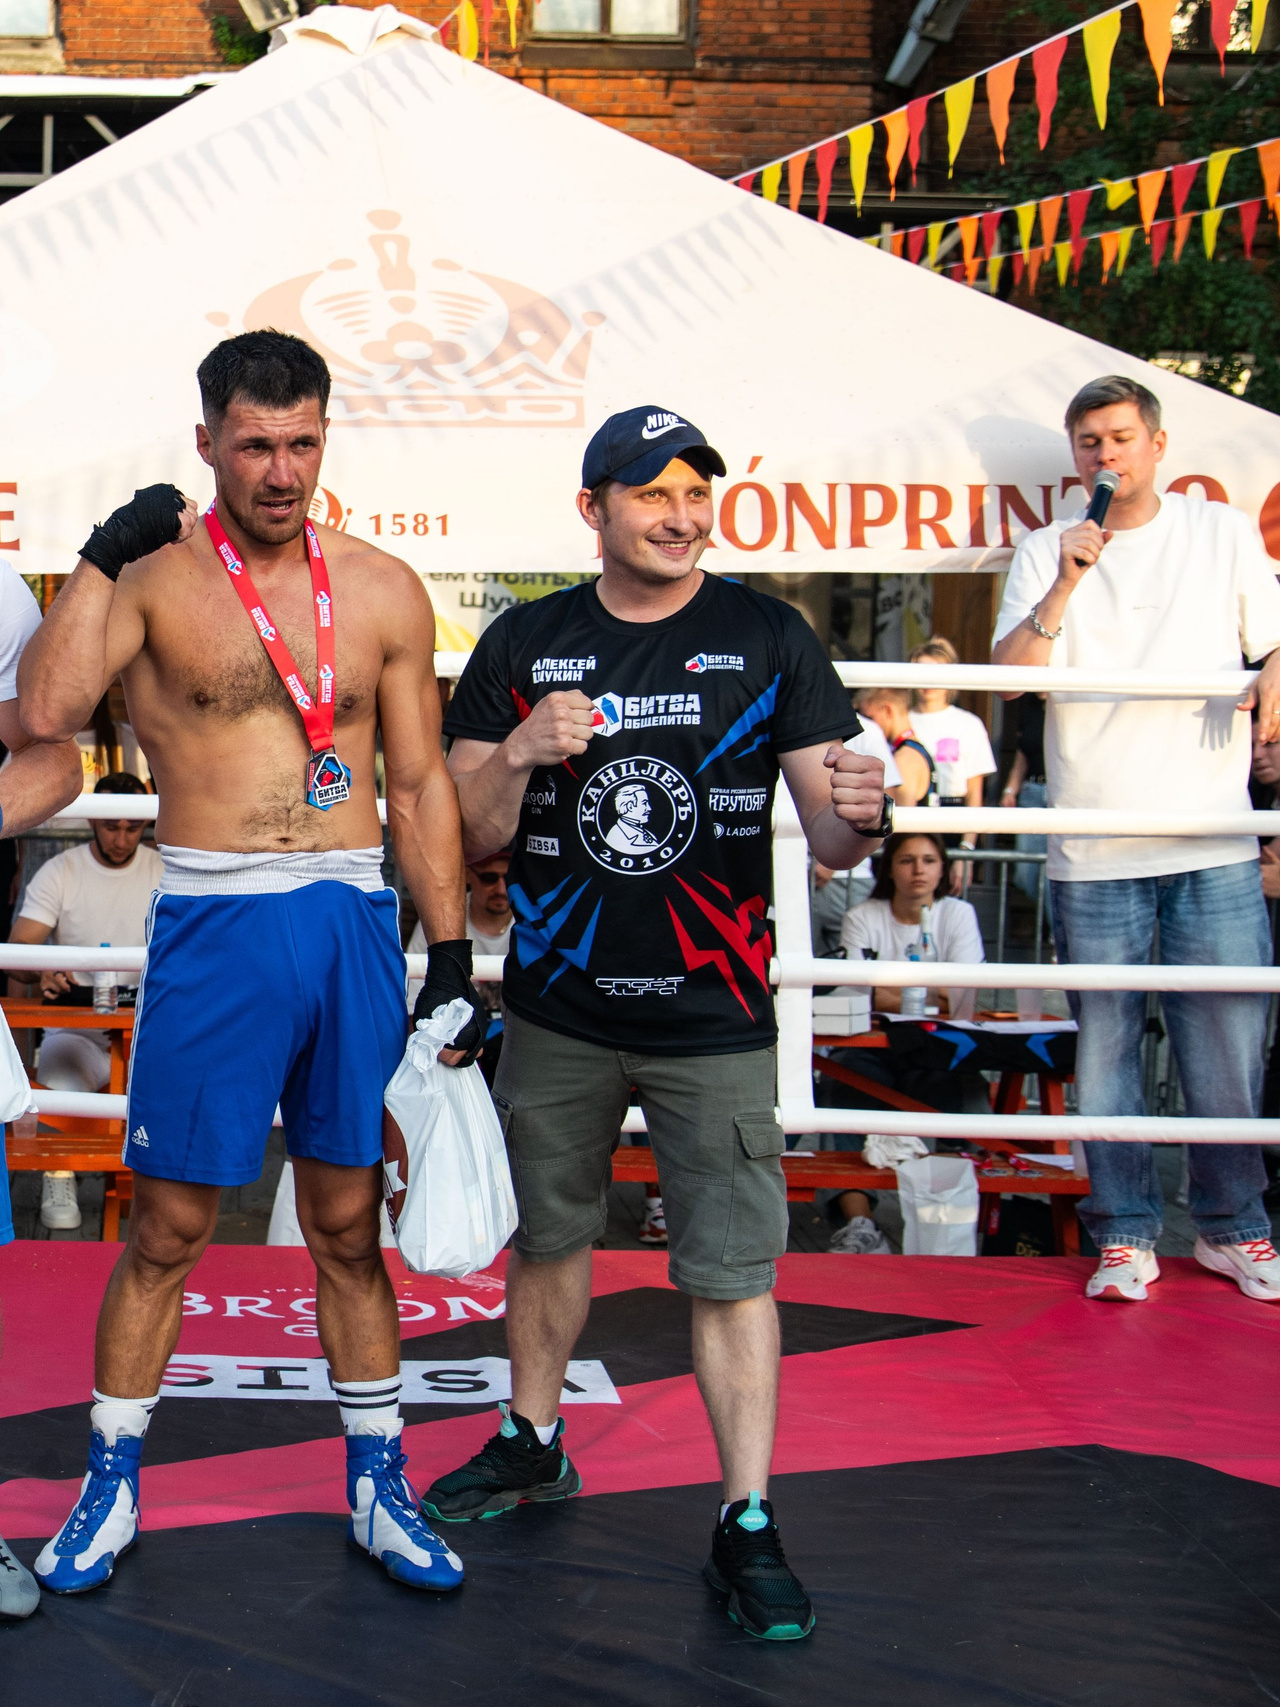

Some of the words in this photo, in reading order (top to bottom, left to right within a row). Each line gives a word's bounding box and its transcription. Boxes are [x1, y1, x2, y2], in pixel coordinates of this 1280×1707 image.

[646, 412, 679, 430] NIKE
[369, 512, 448, 537] 1581
[531, 655, 597, 672] АЛЕКСЕЙ
[708, 654, 744, 665] БИТВА
[624, 694, 702, 717] БИТВА
[624, 714, 701, 729] ОБЩЕПИТОВ
[317, 784, 347, 799] БИТВА
[581, 760, 693, 822] КАНЦЛЕРЪ
[708, 794, 767, 812] КРУТОЯР
[726, 825, 761, 837] LADOGA
[528, 838, 557, 853] SIBSA
[599, 846, 674, 869] 2010
[161, 1362, 588, 1394] SIS
